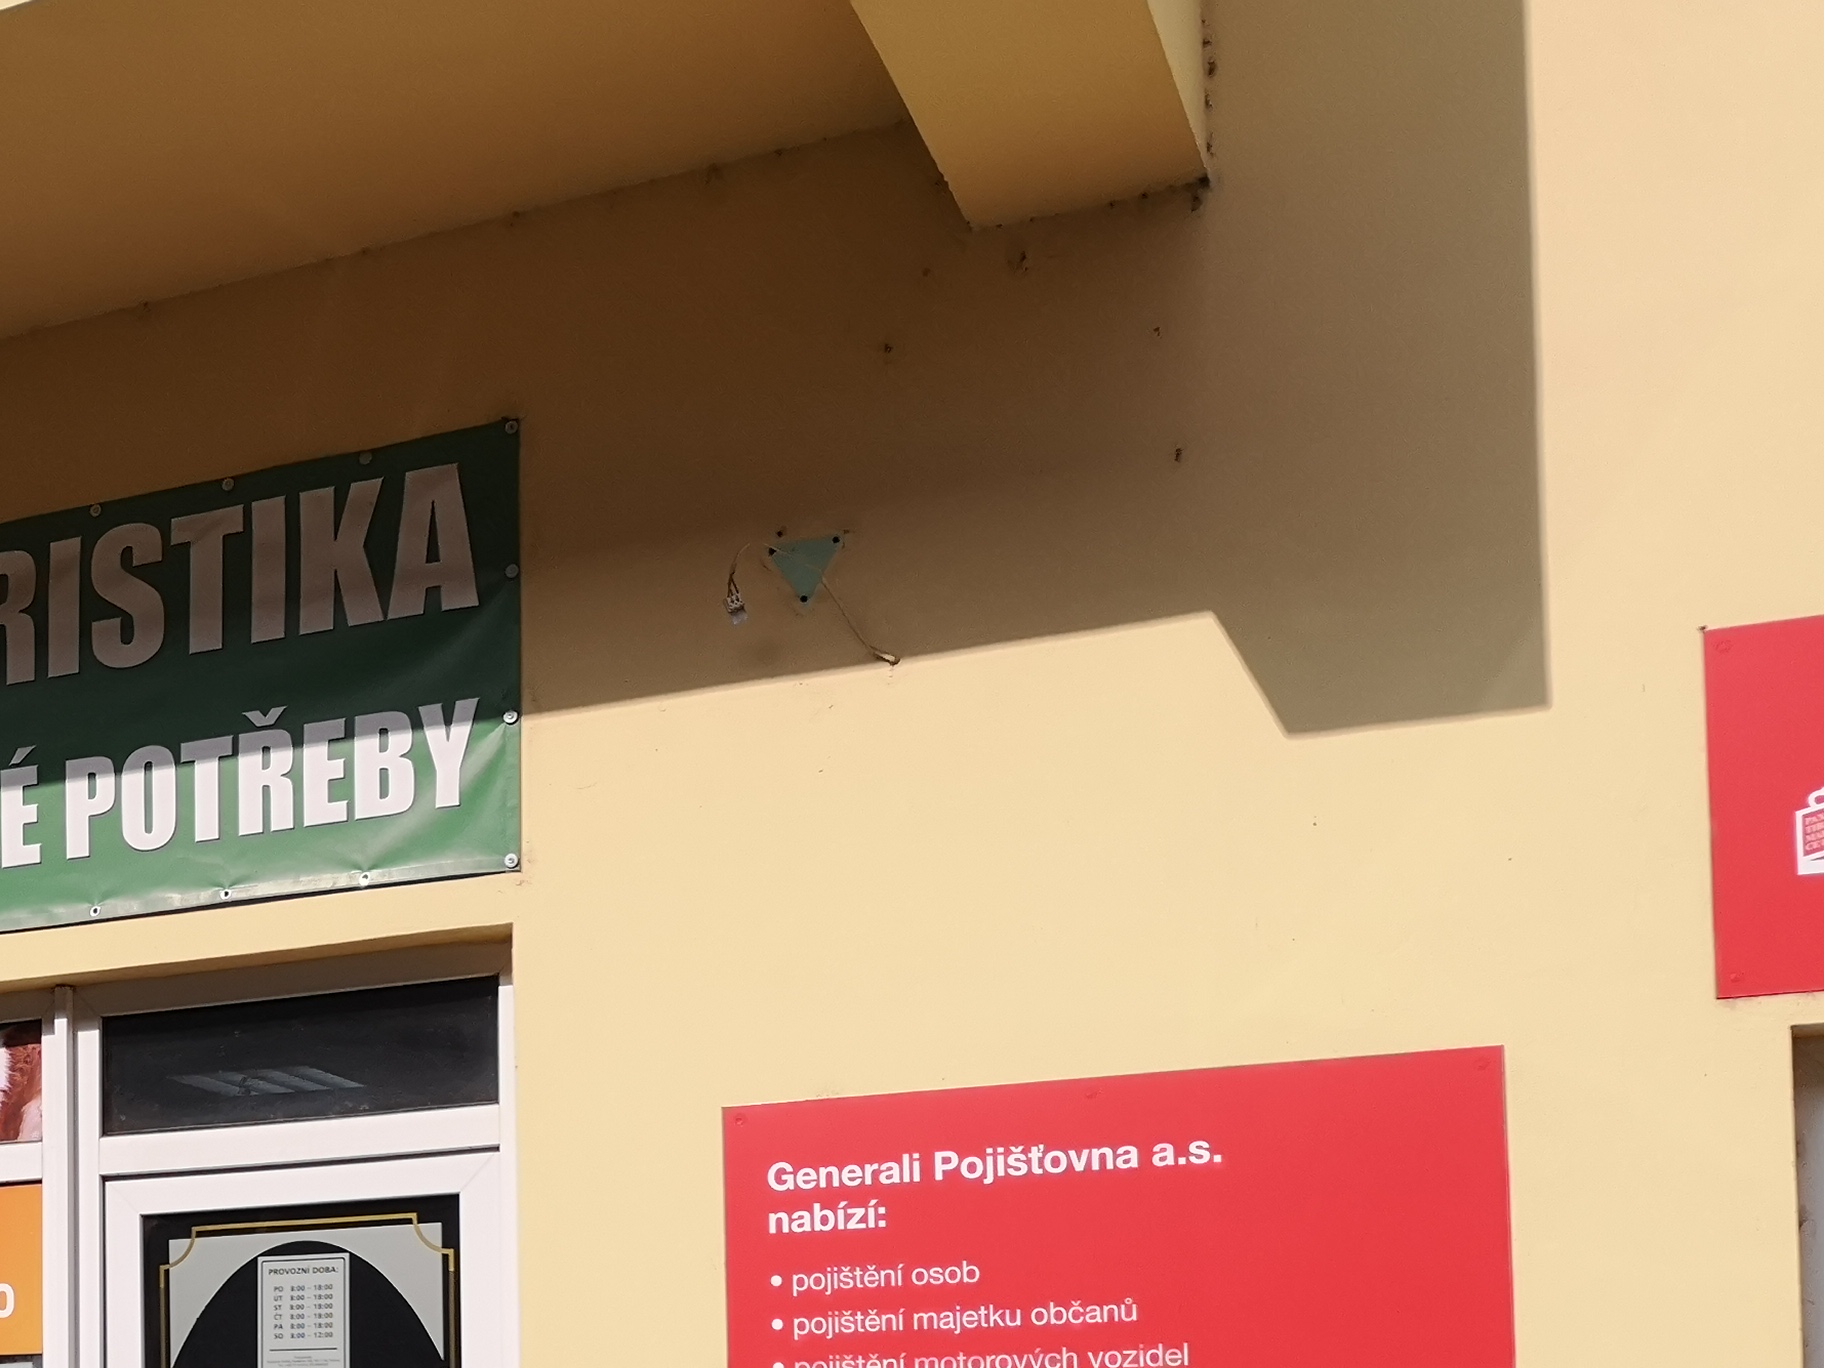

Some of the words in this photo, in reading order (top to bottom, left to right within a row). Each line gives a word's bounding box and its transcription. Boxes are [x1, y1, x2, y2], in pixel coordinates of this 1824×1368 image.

[64, 697, 481, 860] POTŘEBY
[766, 1153, 922, 1193] Generali
[934, 1142, 1140, 1187] Pojišťovna
[1151, 1135, 1223, 1168] a.s.
[767, 1200, 888, 1237] nabízí:
[268, 1266, 310, 1275] PROVOZNÍ
[312, 1265, 339, 1274] DOBA:
[791, 1262, 904, 1297] pojištění
[910, 1260, 980, 1288] osob
[792, 1307, 905, 1341] pojištění
[912, 1301, 1022, 1335] majetku
[1030, 1296, 1138, 1327] občanů
